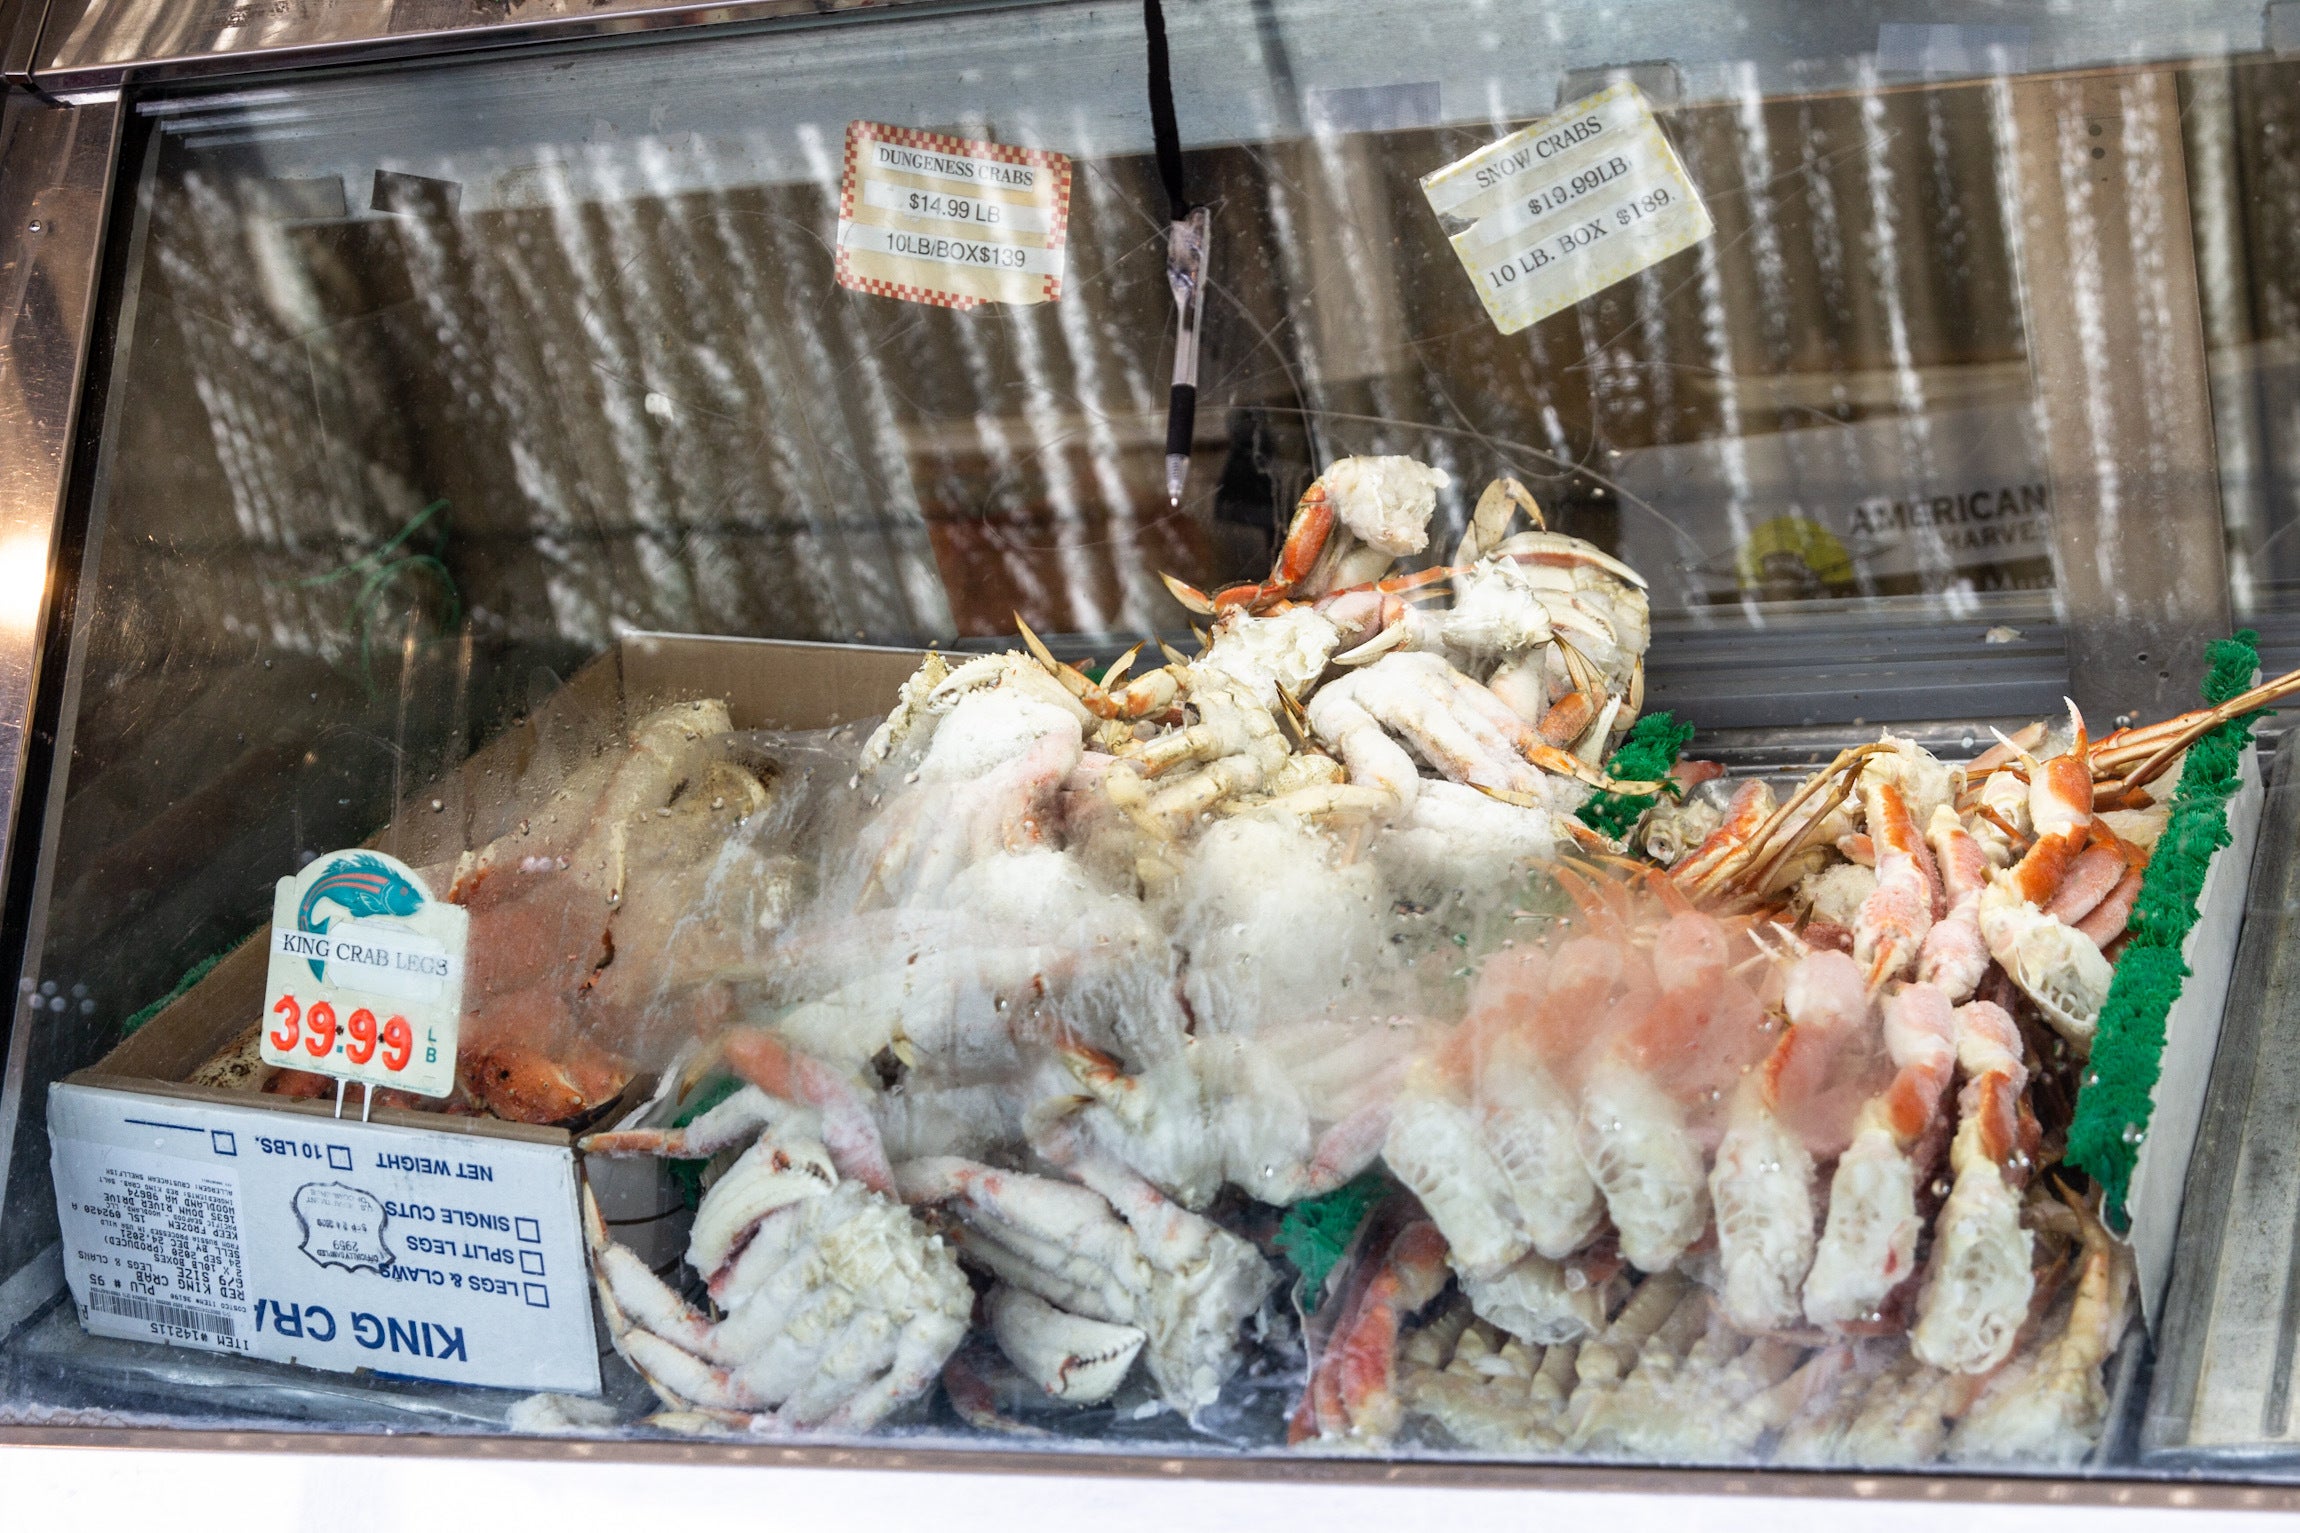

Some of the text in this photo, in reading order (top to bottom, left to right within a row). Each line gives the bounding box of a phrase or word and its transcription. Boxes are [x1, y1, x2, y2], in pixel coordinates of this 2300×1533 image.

[1475, 115, 1602, 188] SNOW CRABS
[880, 148, 1033, 186] DUNGENESS CRABS
[909, 193, 1000, 223] $14.99 LB
[887, 233, 1025, 268] 10LB/BOX$139
[1489, 264, 1516, 288] 10
[1522, 247, 1556, 274] LB.
[1557, 219, 1608, 255] BOX
[1850, 484, 2047, 535] AMERICAN
[284, 934, 448, 977] KING CRAB LEGS
[270, 994, 413, 1072] 39.99
[254, 1136, 323, 1159] 10 LBS.
[105, 1168, 144, 1180] SHELLFISH
[375, 1152, 493, 1182] NET WEIGHT
[99, 1176, 116, 1184] SALT
[144, 1184, 162, 1193] KING
[147, 1176, 190, 1189] CRUSTACEAN
[127, 1188, 235, 1214] WOODLAND WA 98674
[166, 1188, 179, 1196] RED
[71, 1202, 145, 1223] 15L 092420 A
[103, 1192, 235, 1224] 1635 DOWN RIVER DRIVE
[384, 1200, 511, 1233] SINGLE CUTS
[100, 1219, 117, 1228] WILD
[121, 1222, 134, 1230] USA
[168, 1220, 238, 1241] KEEP FROZEN
[173, 1214, 203, 1225] SEAFOOD
[207, 1220, 237, 1231] PACIFIC
[150, 1228, 189, 1241] PROCESSED
[170, 1238, 189, 1250] DEC
[192, 1236, 218, 1245] RUSSIA
[221, 1241, 240, 1250] FROM
[104, 1235, 241, 1268] 24 SEP 2020 (PRODUCED)
[196, 1244, 208, 1253] BY
[214, 1246, 240, 1259] SELL
[332, 1240, 359, 1252] 2959
[405, 1235, 514, 1265] SPLIT LEGS
[78, 1250, 153, 1272] LEGS & CLAWS
[153, 1253, 242, 1277] 2 X 10LB BOXES
[89, 1273, 155, 1295] PLU # 95
[136, 1271, 245, 1301] RED KING CRAB
[176, 1266, 243, 1288] 6/9 SIZE
[378, 1263, 519, 1297] LEGS & CLAWS
[220, 1302, 246, 1313] COSTCO
[150, 1322, 249, 1351] ITEM #142115
[349, 1311, 468, 1363] KING
